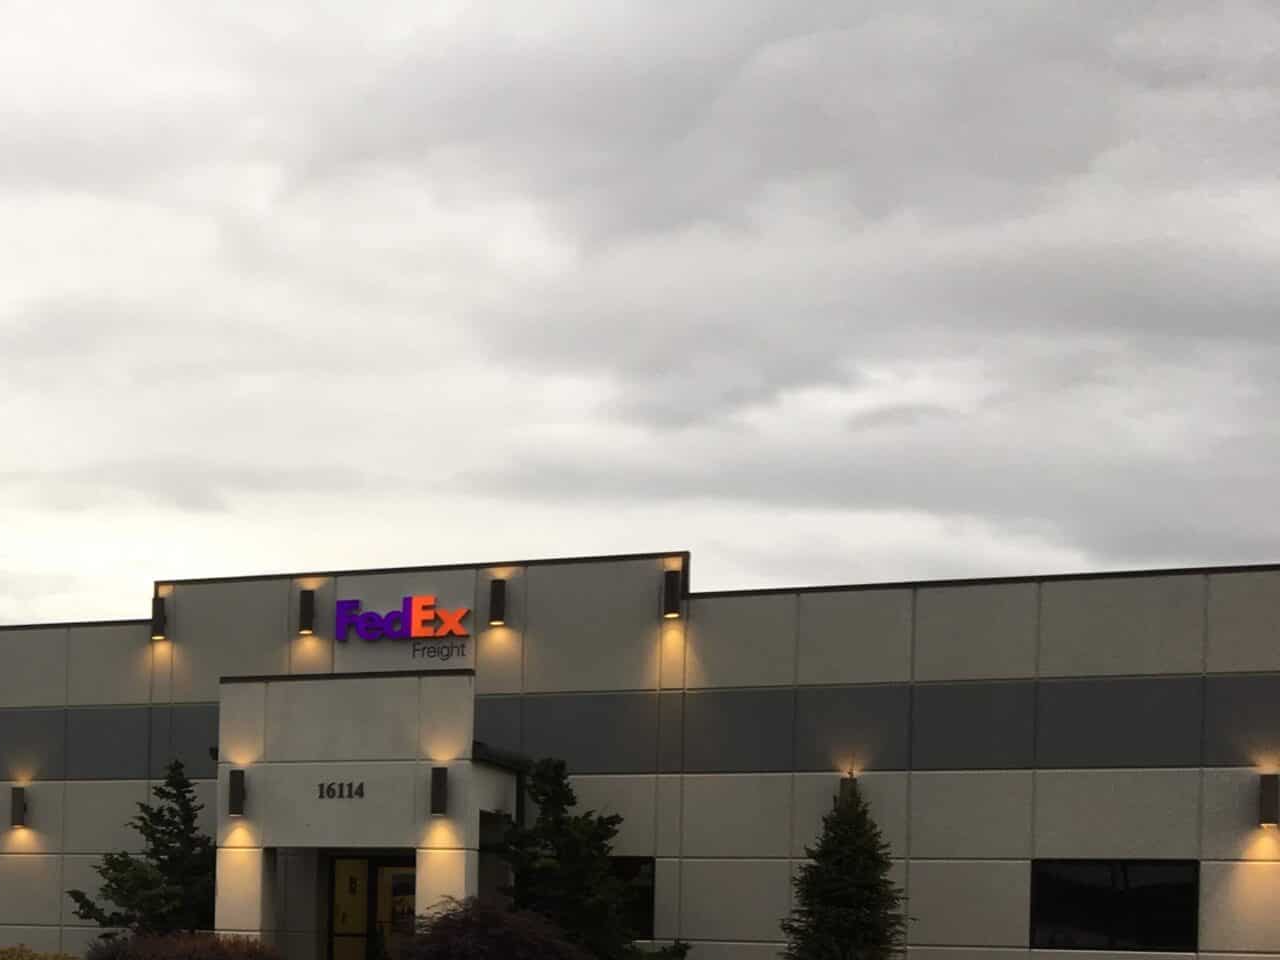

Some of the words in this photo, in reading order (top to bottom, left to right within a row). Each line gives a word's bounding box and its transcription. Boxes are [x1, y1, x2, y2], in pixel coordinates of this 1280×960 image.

[336, 596, 470, 641] FedEx
[412, 643, 465, 660] Freight
[318, 782, 364, 799] 16114
